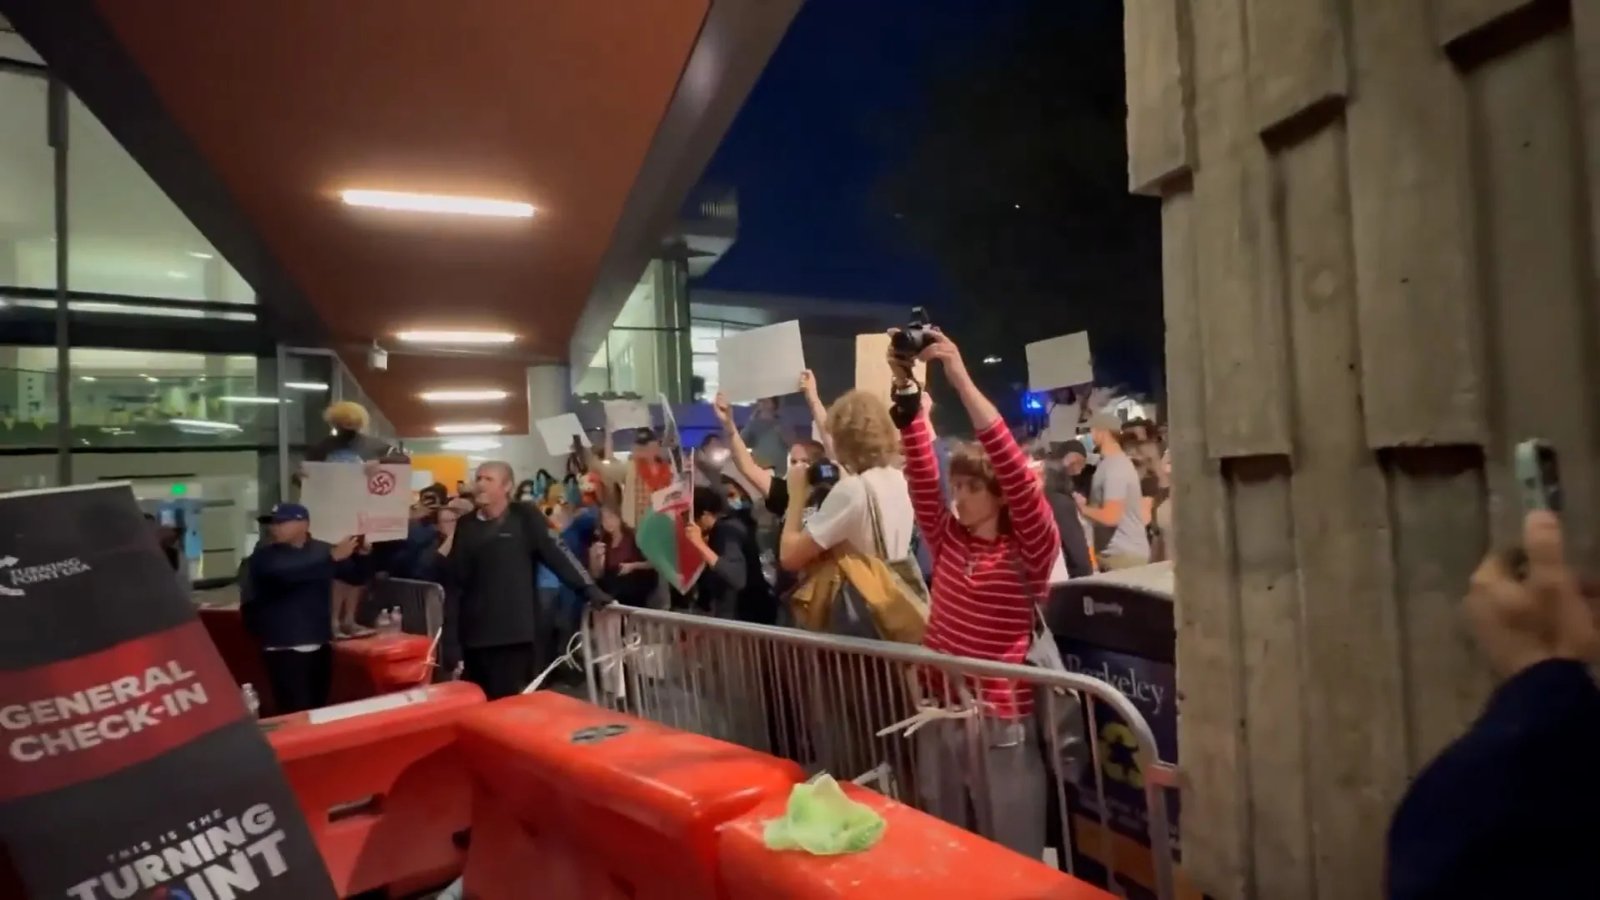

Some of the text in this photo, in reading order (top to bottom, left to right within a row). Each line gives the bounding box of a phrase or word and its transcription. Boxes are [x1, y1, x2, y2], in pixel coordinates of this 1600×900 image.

[11, 557, 81, 579] TURNING
[13, 563, 92, 585] POINT USA
[0, 660, 196, 730] GENERAL
[9, 682, 208, 762] CHECK-IN
[66, 803, 276, 900] TURNING
[107, 808, 223, 863] THIS IS THE
